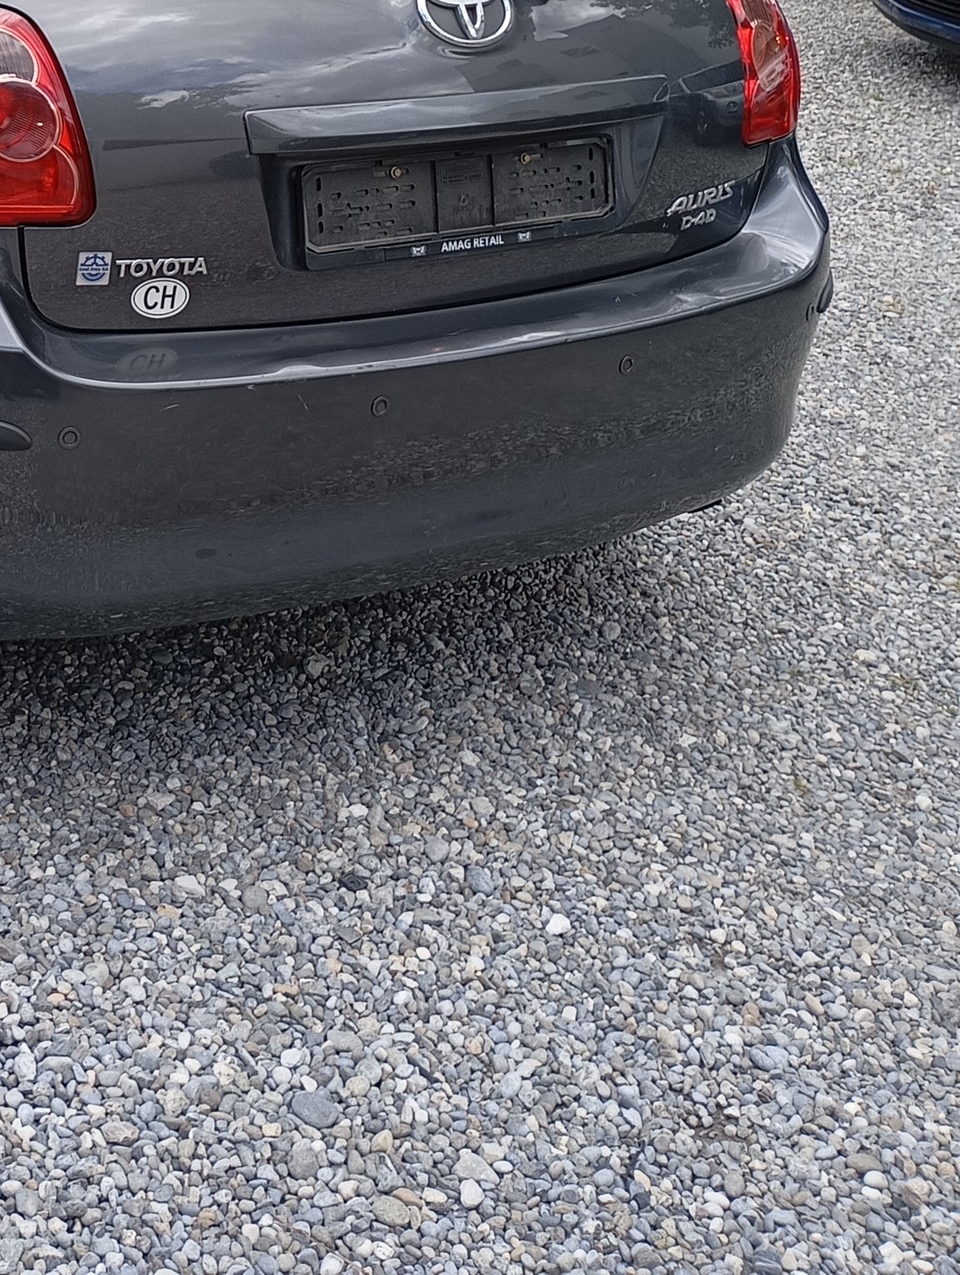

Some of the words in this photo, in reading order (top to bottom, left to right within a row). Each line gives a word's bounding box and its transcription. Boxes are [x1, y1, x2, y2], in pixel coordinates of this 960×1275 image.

[666, 179, 736, 218] AURIS
[441, 238, 472, 253] AMAG
[473, 234, 505, 249] RETAIL
[115, 256, 208, 278] TOYOTA
[143, 284, 178, 311] CH
